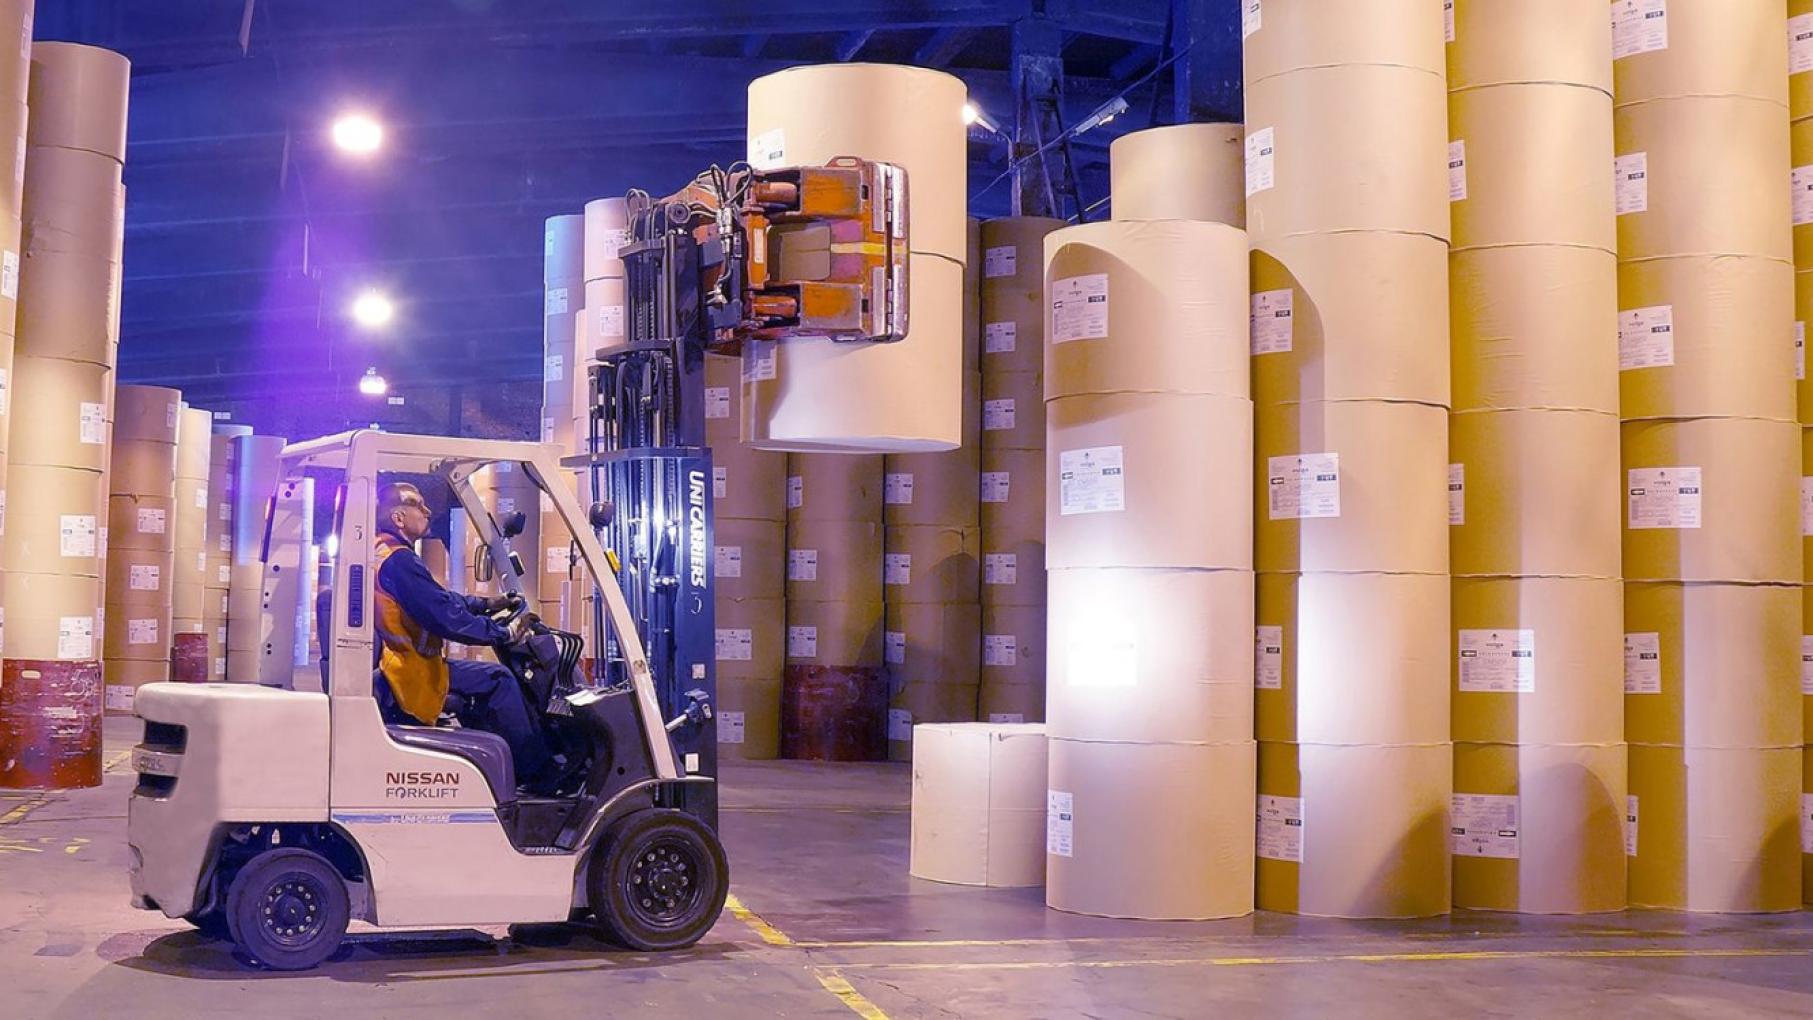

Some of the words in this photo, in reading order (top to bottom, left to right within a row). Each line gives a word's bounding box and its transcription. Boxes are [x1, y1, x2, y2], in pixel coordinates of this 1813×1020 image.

[689, 470, 707, 589] UNICARRIERS
[386, 772, 460, 785] NISSAN
[386, 787, 459, 799] FORKLIFT
